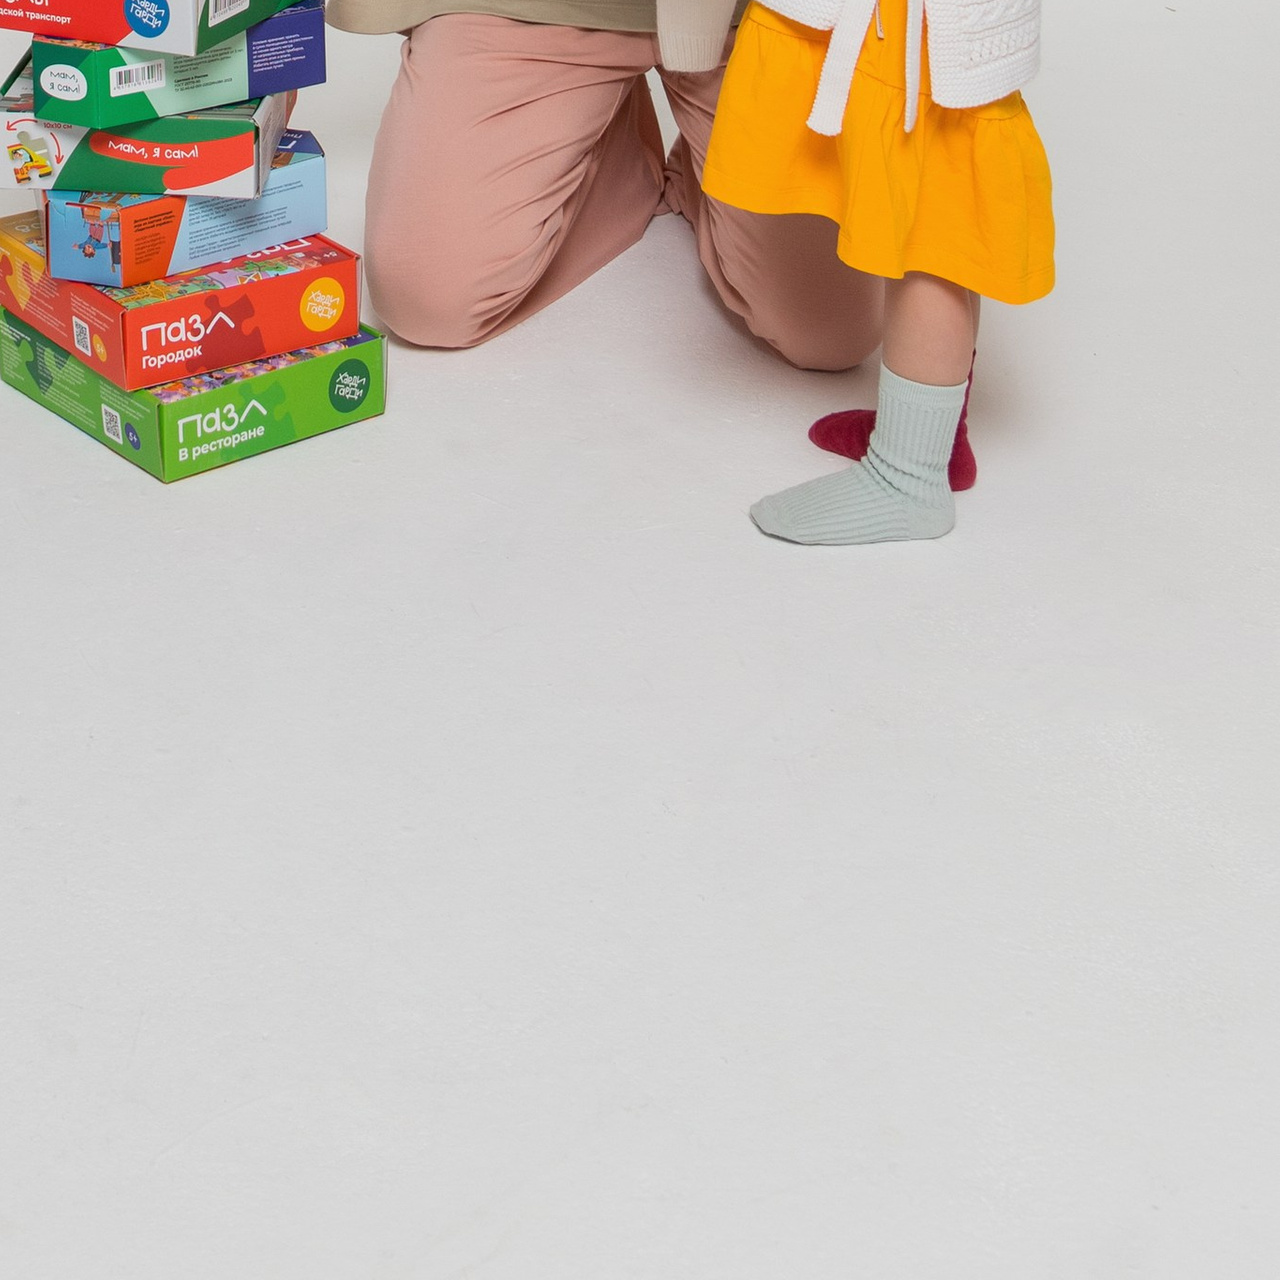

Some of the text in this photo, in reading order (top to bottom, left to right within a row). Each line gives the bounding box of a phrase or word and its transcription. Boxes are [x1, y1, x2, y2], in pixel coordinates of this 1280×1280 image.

[26, 11, 72, 25] транспорт
[142, 344, 203, 370] Городок
[192, 424, 266, 461] ресторане
